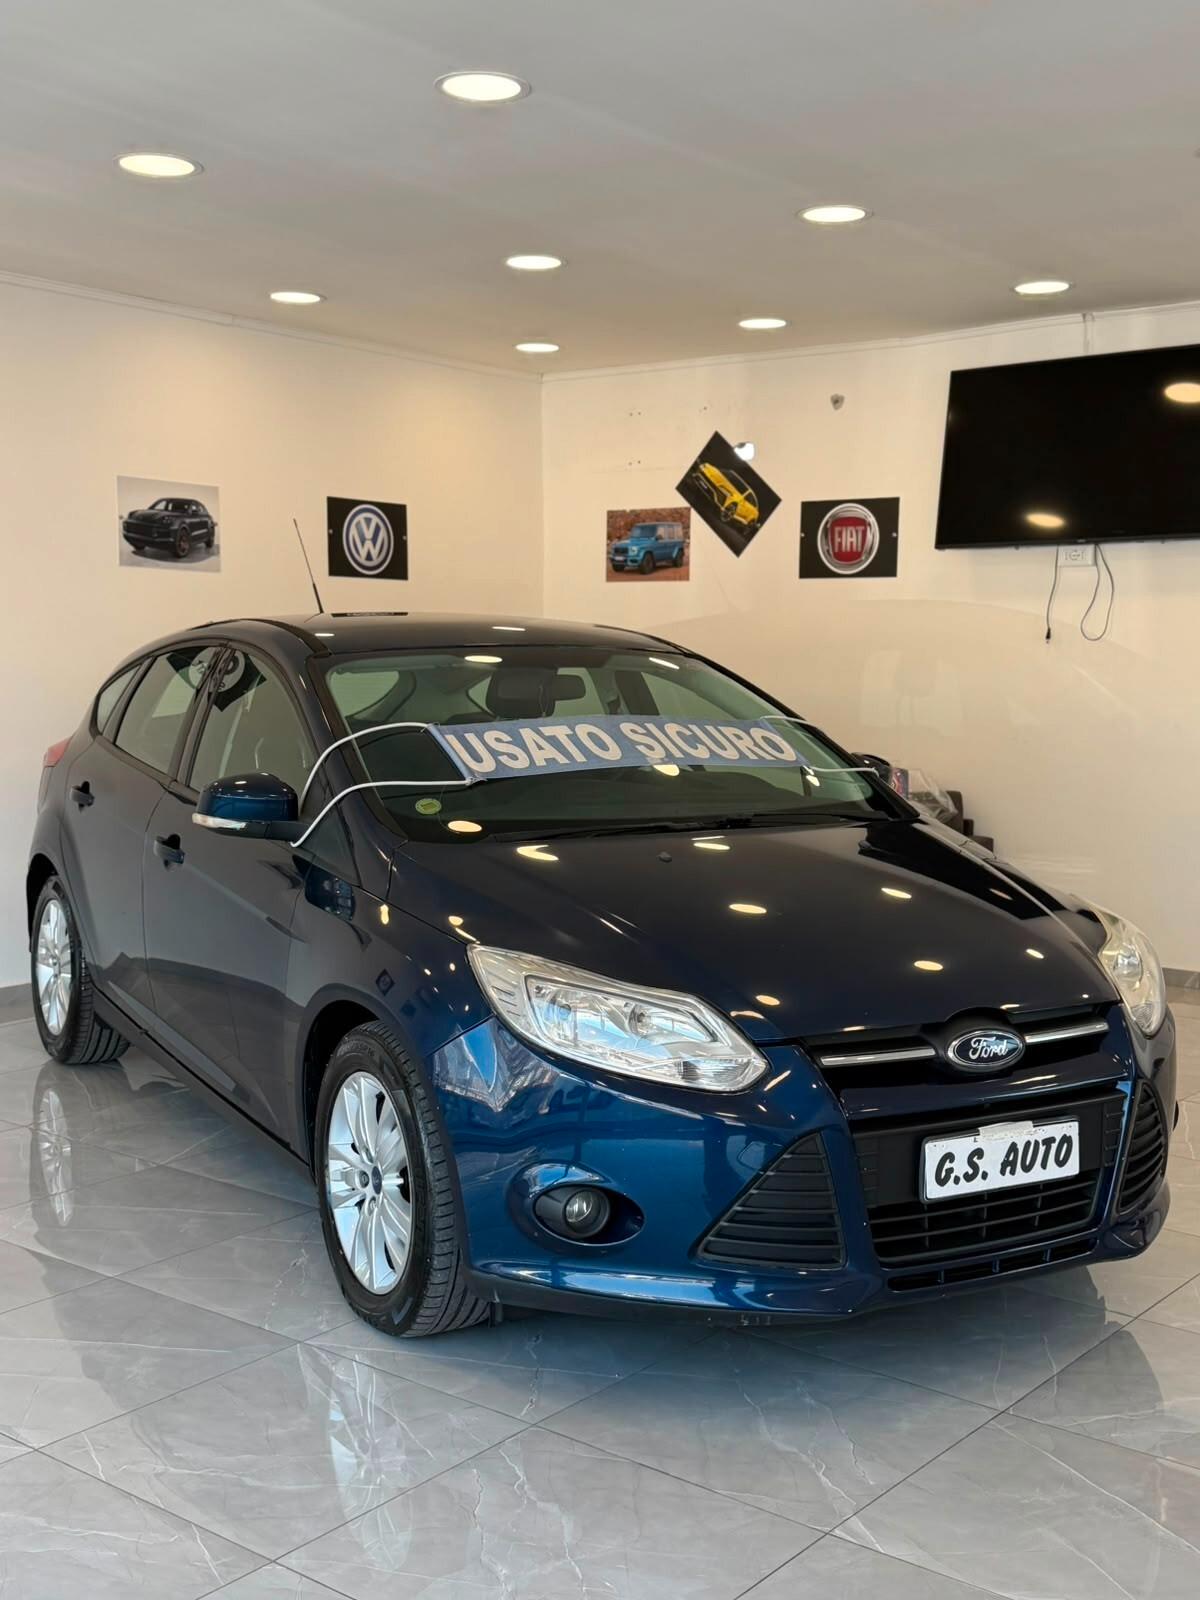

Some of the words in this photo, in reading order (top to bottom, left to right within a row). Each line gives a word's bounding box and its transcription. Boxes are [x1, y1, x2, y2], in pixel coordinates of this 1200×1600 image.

[833, 525, 865, 553] FIAT
[444, 723, 623, 774] USATO
[618, 722, 798, 763] SICURO
[968, 1036, 1010, 1060] Ford
[934, 1147, 989, 1188] G.S.
[999, 1133, 1074, 1177] AUTO
